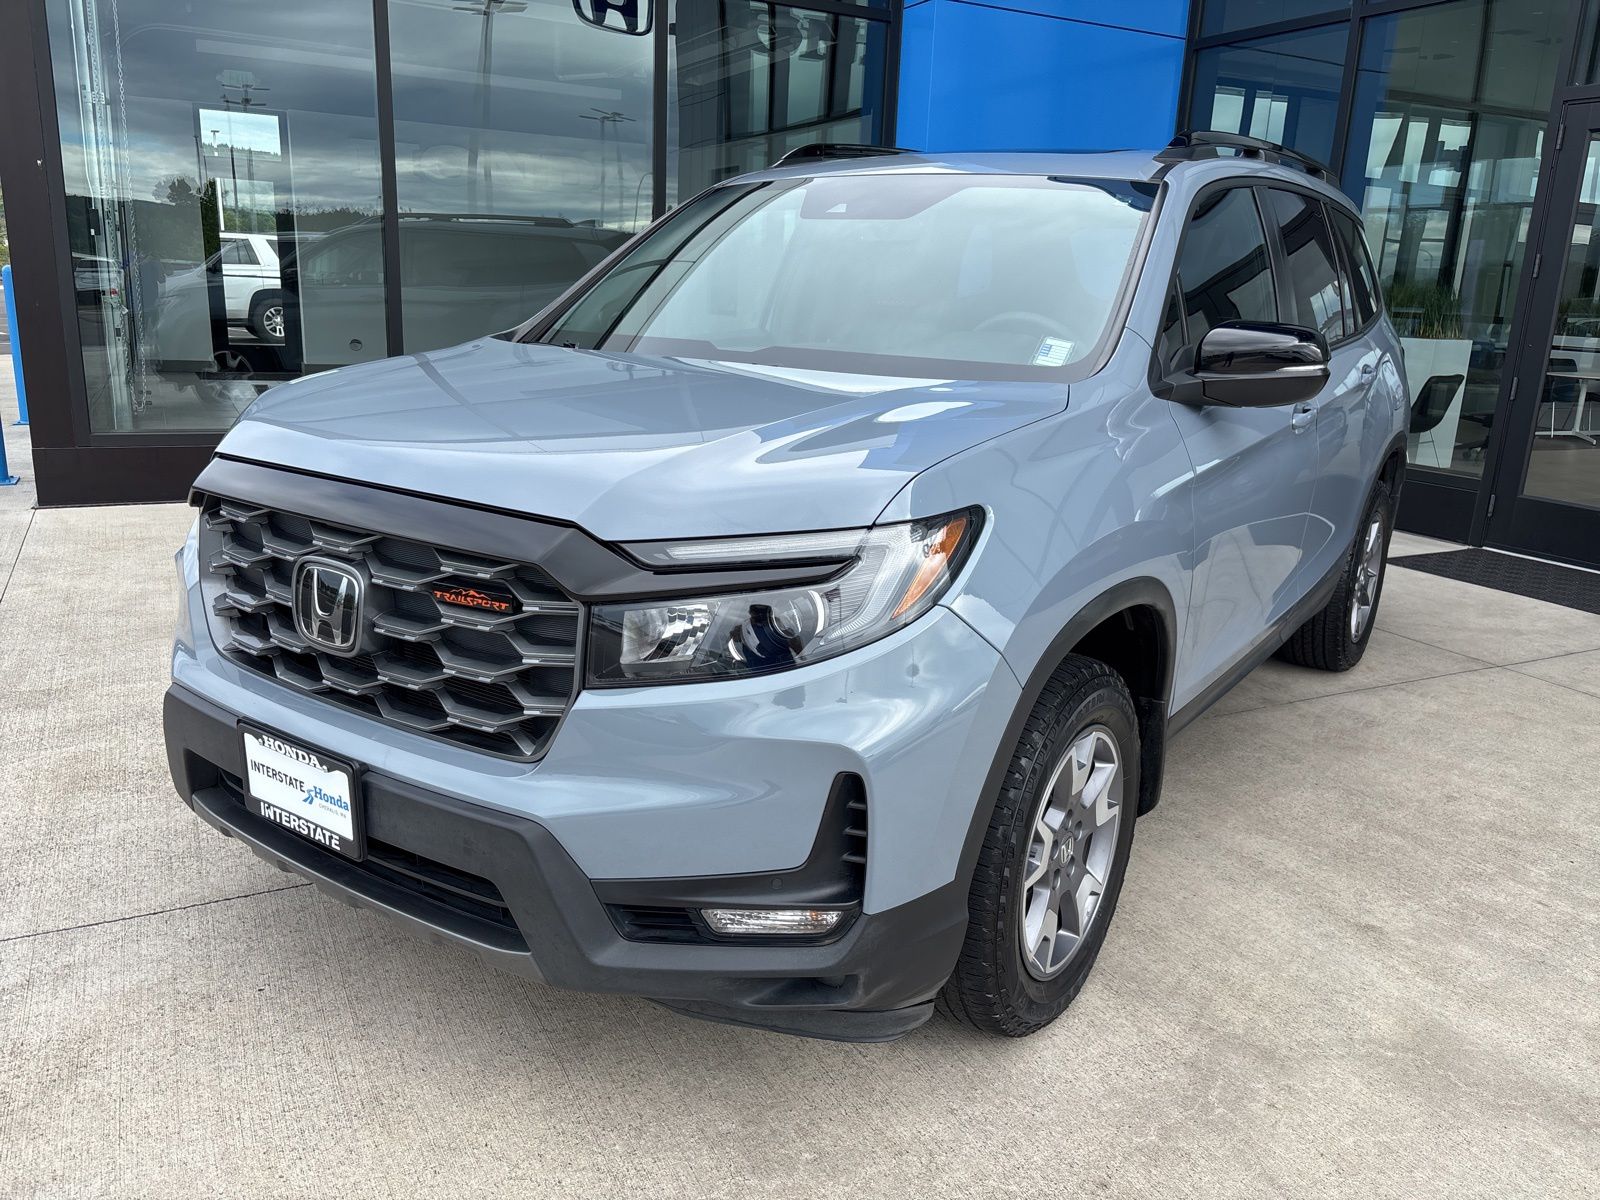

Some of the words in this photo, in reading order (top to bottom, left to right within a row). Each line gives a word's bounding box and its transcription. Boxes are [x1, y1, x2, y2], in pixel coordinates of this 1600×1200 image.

[434, 591, 509, 611] TRAILSPORT
[262, 735, 322, 769] HONDA
[250, 759, 305, 793] INTERSTATE
[313, 785, 350, 812] Honda
[260, 801, 341, 851] INTERSTATE
